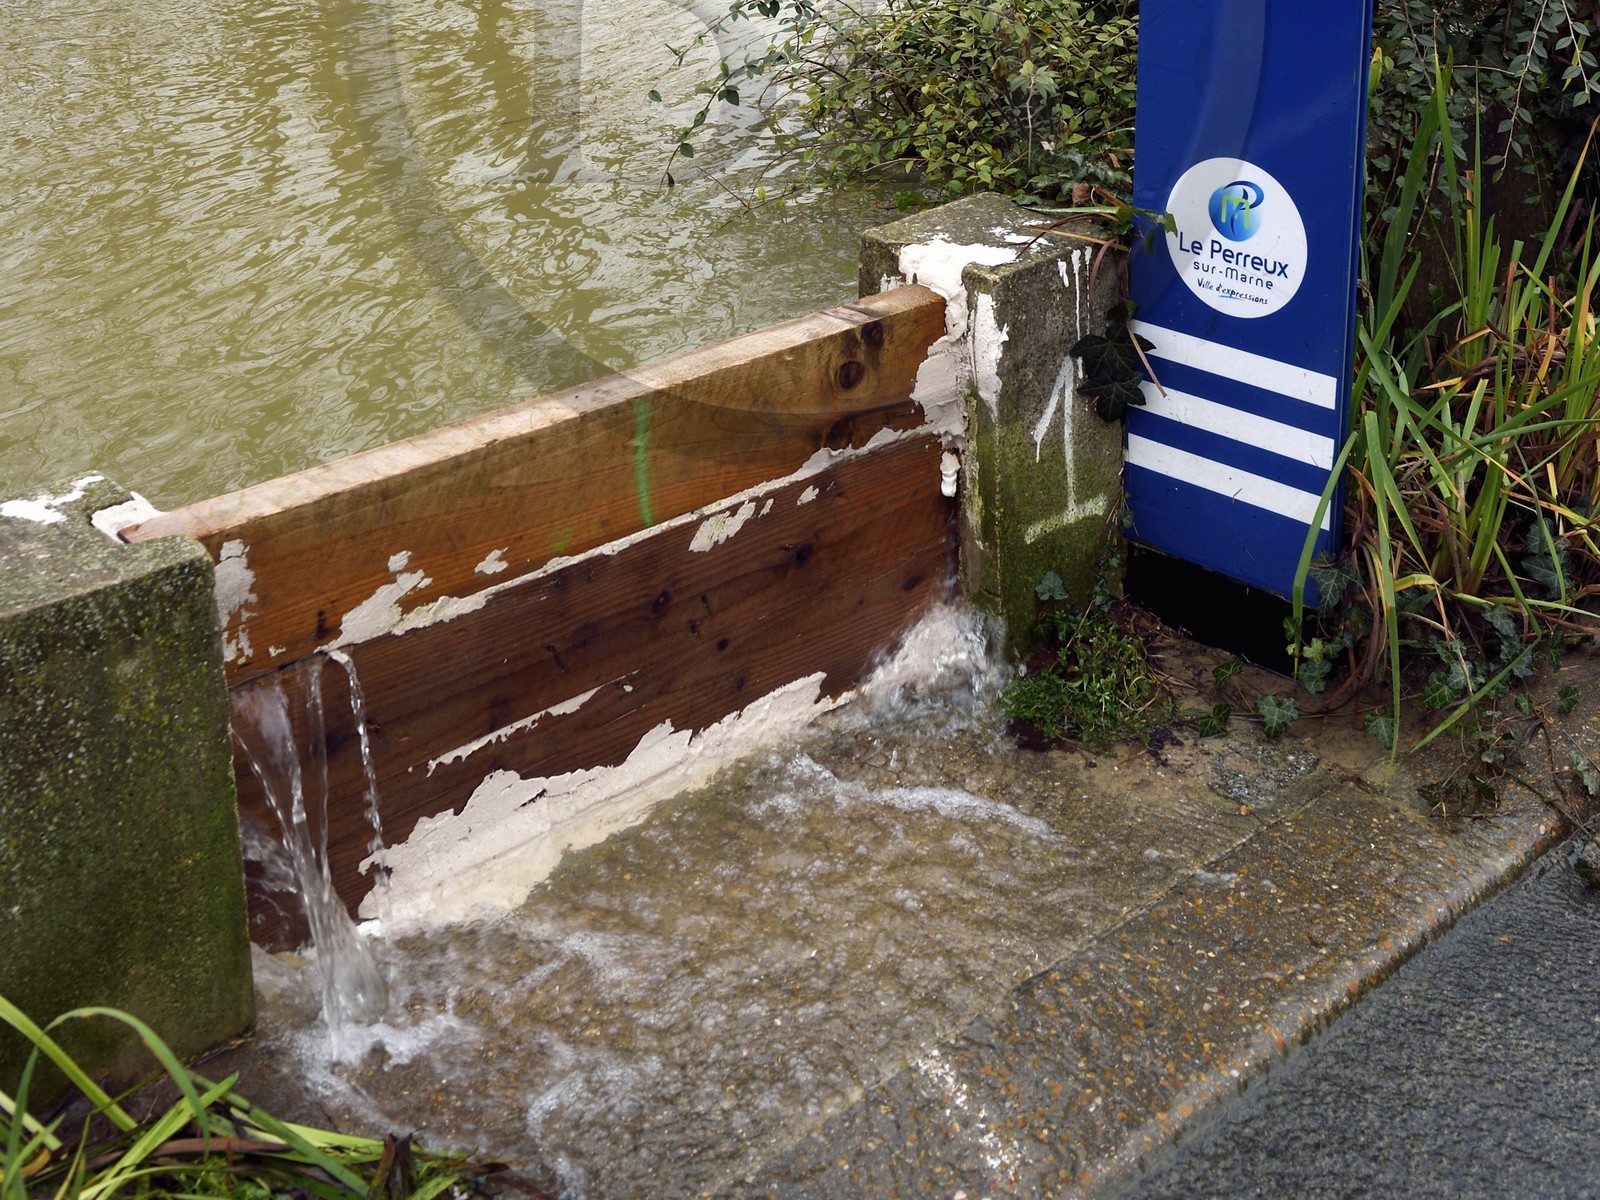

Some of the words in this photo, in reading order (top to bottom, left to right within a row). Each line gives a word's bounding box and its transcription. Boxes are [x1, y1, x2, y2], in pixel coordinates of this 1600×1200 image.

[1179, 231, 1203, 256] Le
[1210, 239, 1289, 279] Perreux
[1197, 277, 1214, 291] Ville
